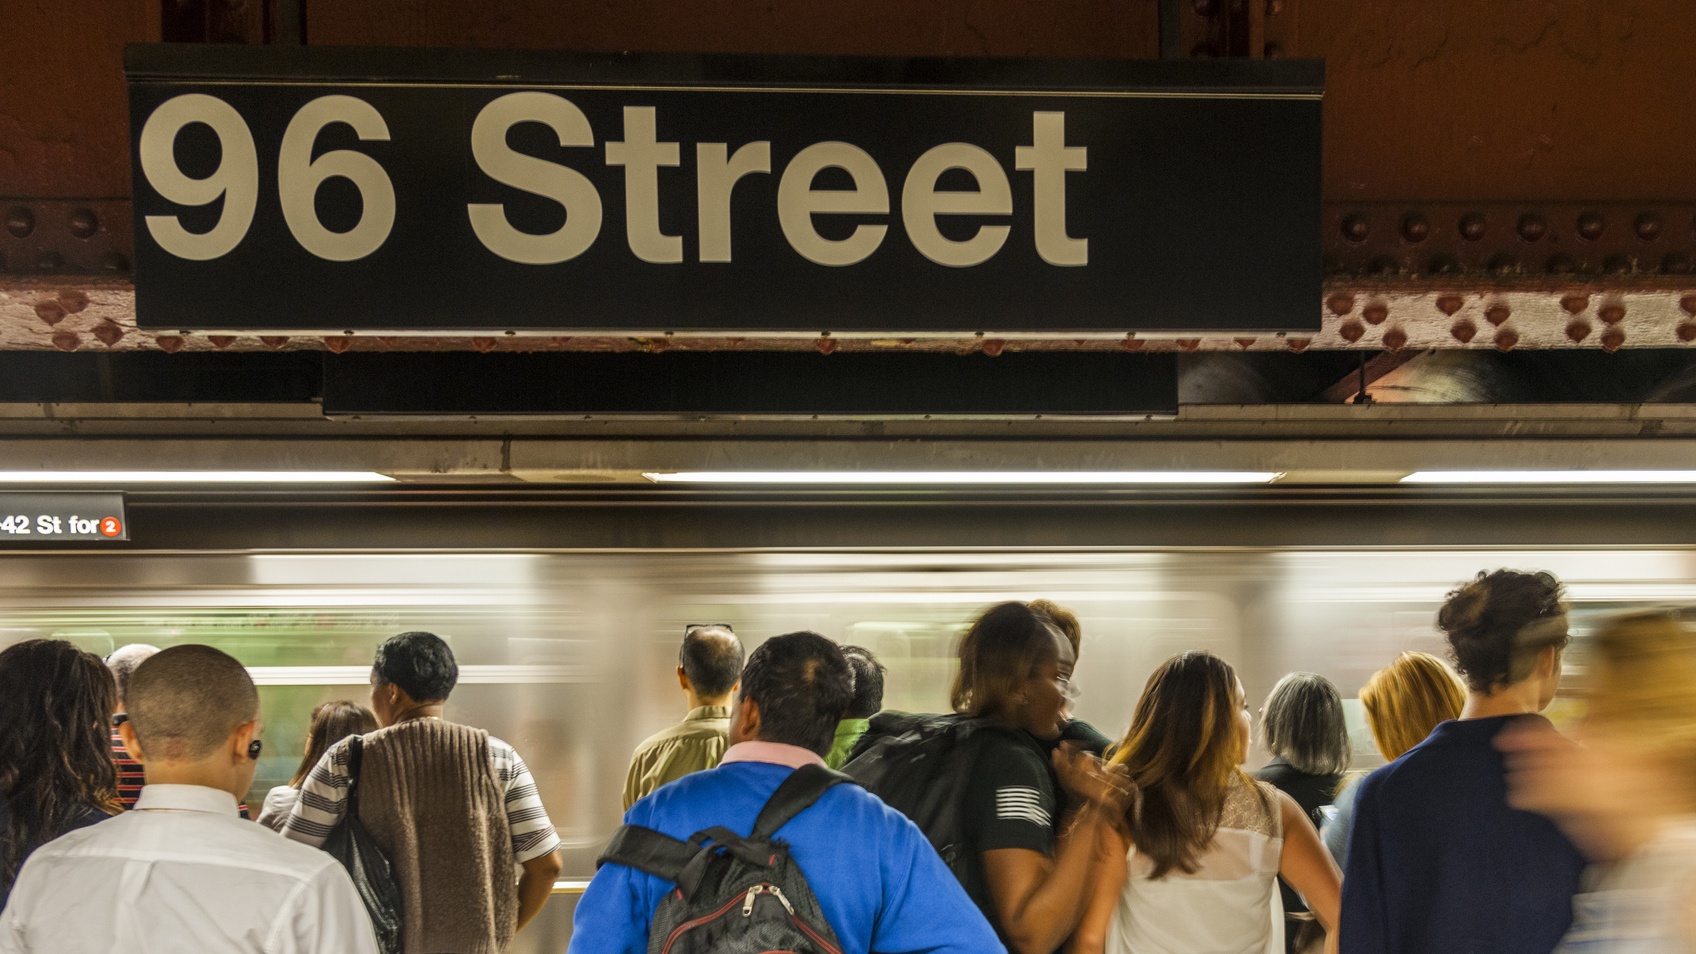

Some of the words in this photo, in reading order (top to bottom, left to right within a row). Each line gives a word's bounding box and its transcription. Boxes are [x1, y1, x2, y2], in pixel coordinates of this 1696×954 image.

[139, 92, 397, 263] 96
[467, 90, 1089, 267] Street
[0, 515, 30, 534] 42
[36, 515, 62, 535] St
[68, 515, 100, 534] for
[104, 519, 117, 533] 2
